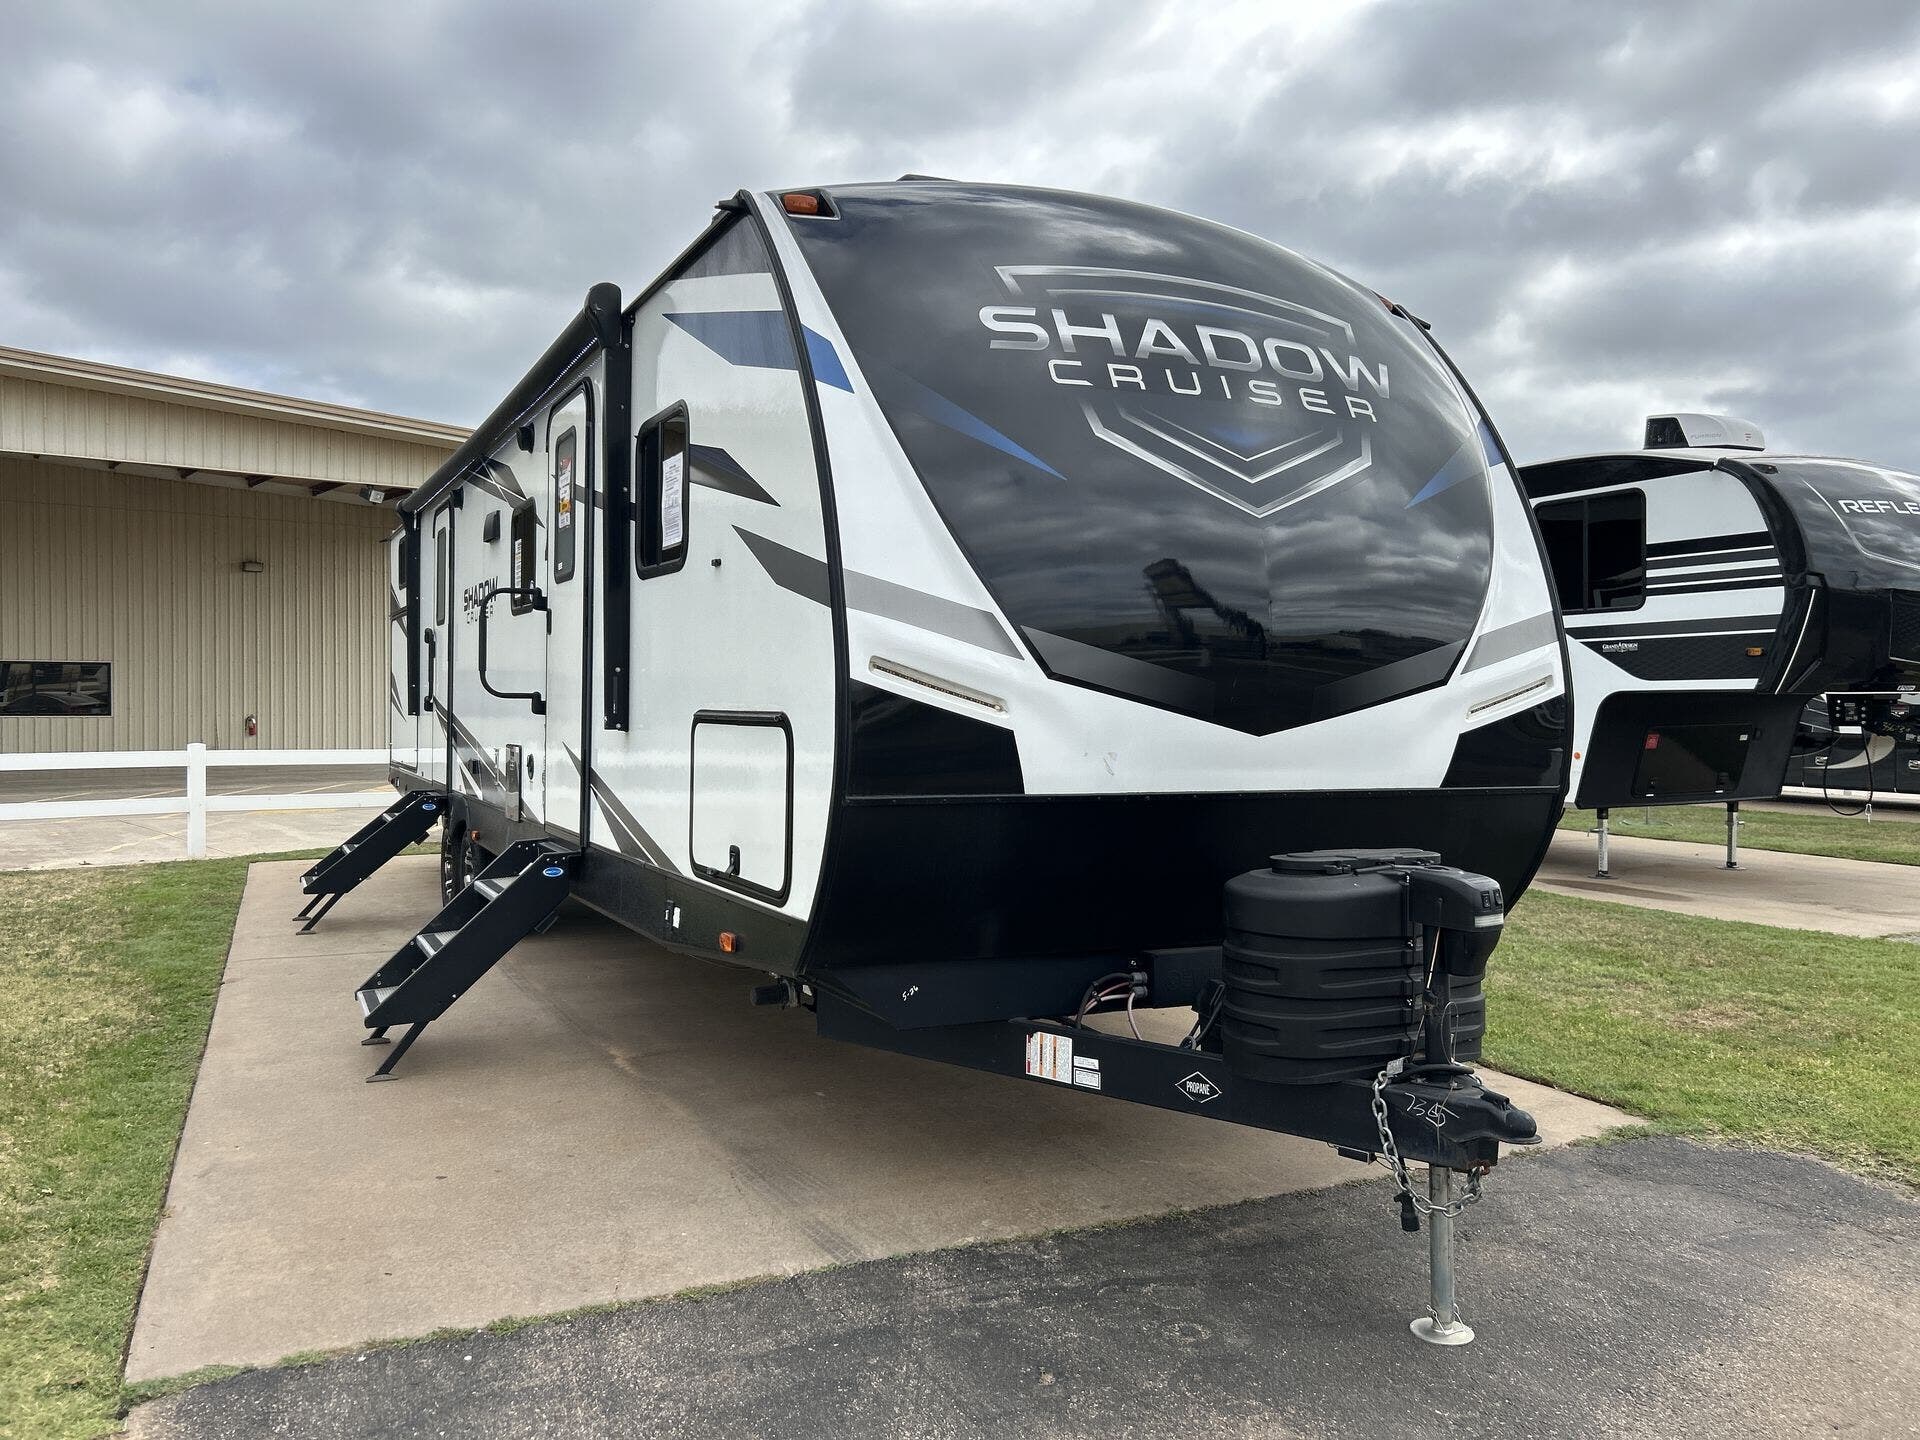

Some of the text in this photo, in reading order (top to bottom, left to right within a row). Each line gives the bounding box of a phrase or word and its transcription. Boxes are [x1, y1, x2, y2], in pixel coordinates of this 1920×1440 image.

[979, 306, 1389, 399] SHADOW
[1048, 359, 1377, 423] CRUISER
[1838, 499, 1920, 514] REFLE
[1186, 1081, 1210, 1096] PROPANE
